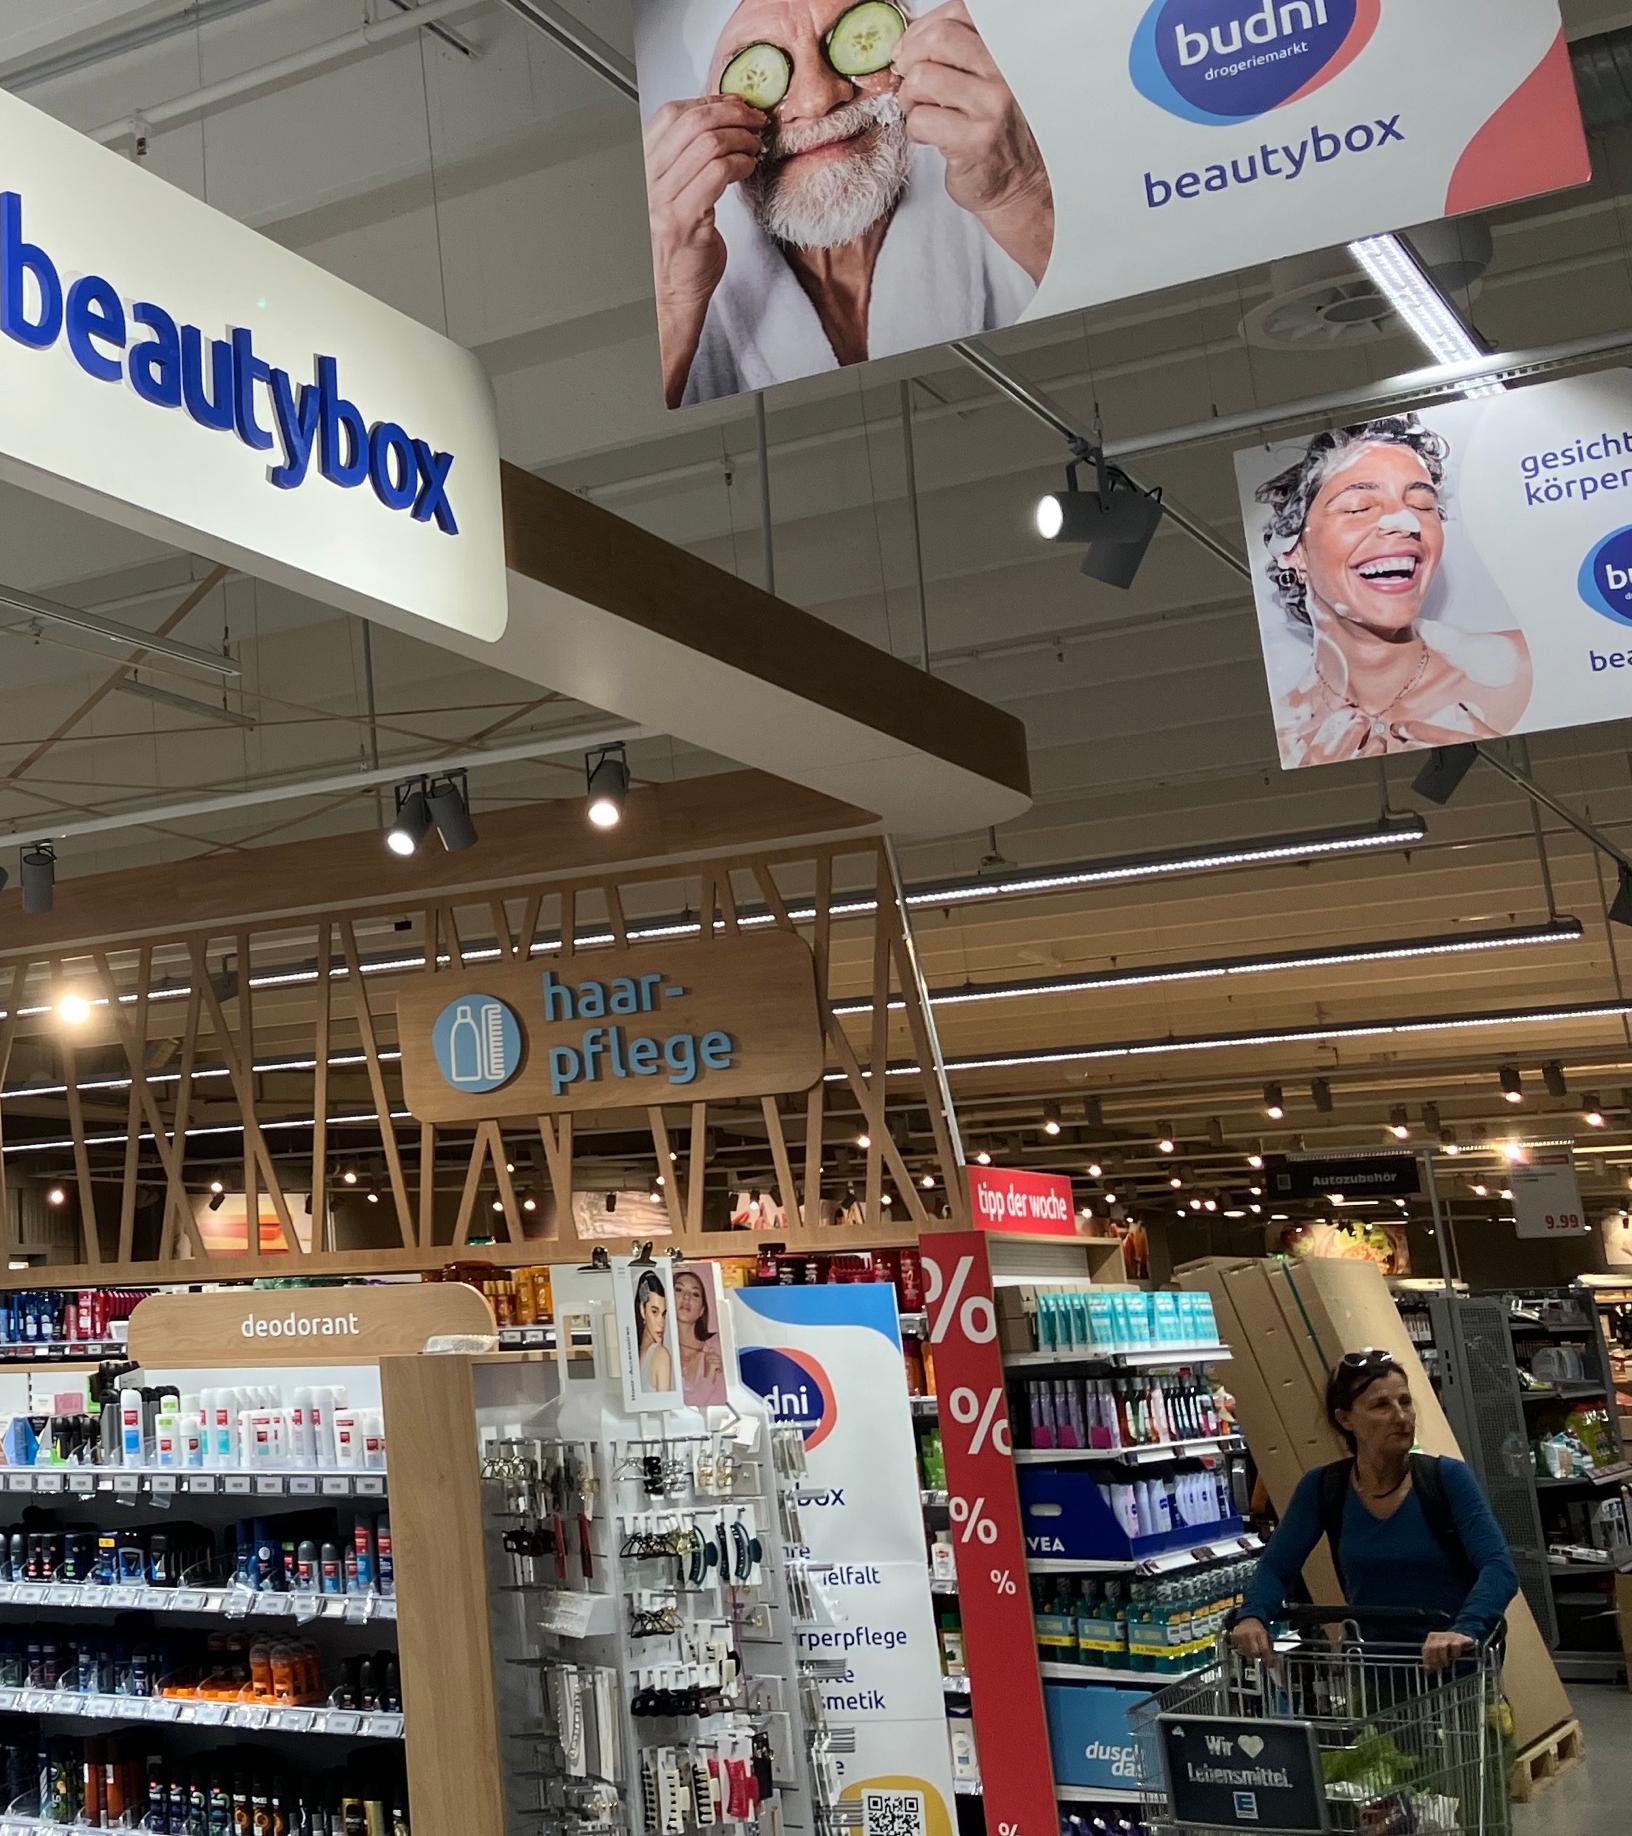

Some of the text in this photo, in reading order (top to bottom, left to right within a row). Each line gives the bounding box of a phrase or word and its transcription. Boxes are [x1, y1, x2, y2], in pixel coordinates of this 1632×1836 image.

[1174, 0, 1329, 67] budni
[1204, 41, 1309, 81] drogeriemarkt
[1144, 114, 1406, 208] beautybox
[543, 970, 685, 1022] haar-
[549, 1026, 734, 1096] pflege
[1312, 1171, 1398, 1188] Autozubehör
[977, 1181, 1067, 1222] tipp der woche
[1545, 1213, 1579, 1230] 9.99
[240, 1311, 360, 1338] deodorant
[1025, 1536, 1065, 1553] VEA
[1204, 1735, 1234, 1757] Wir
